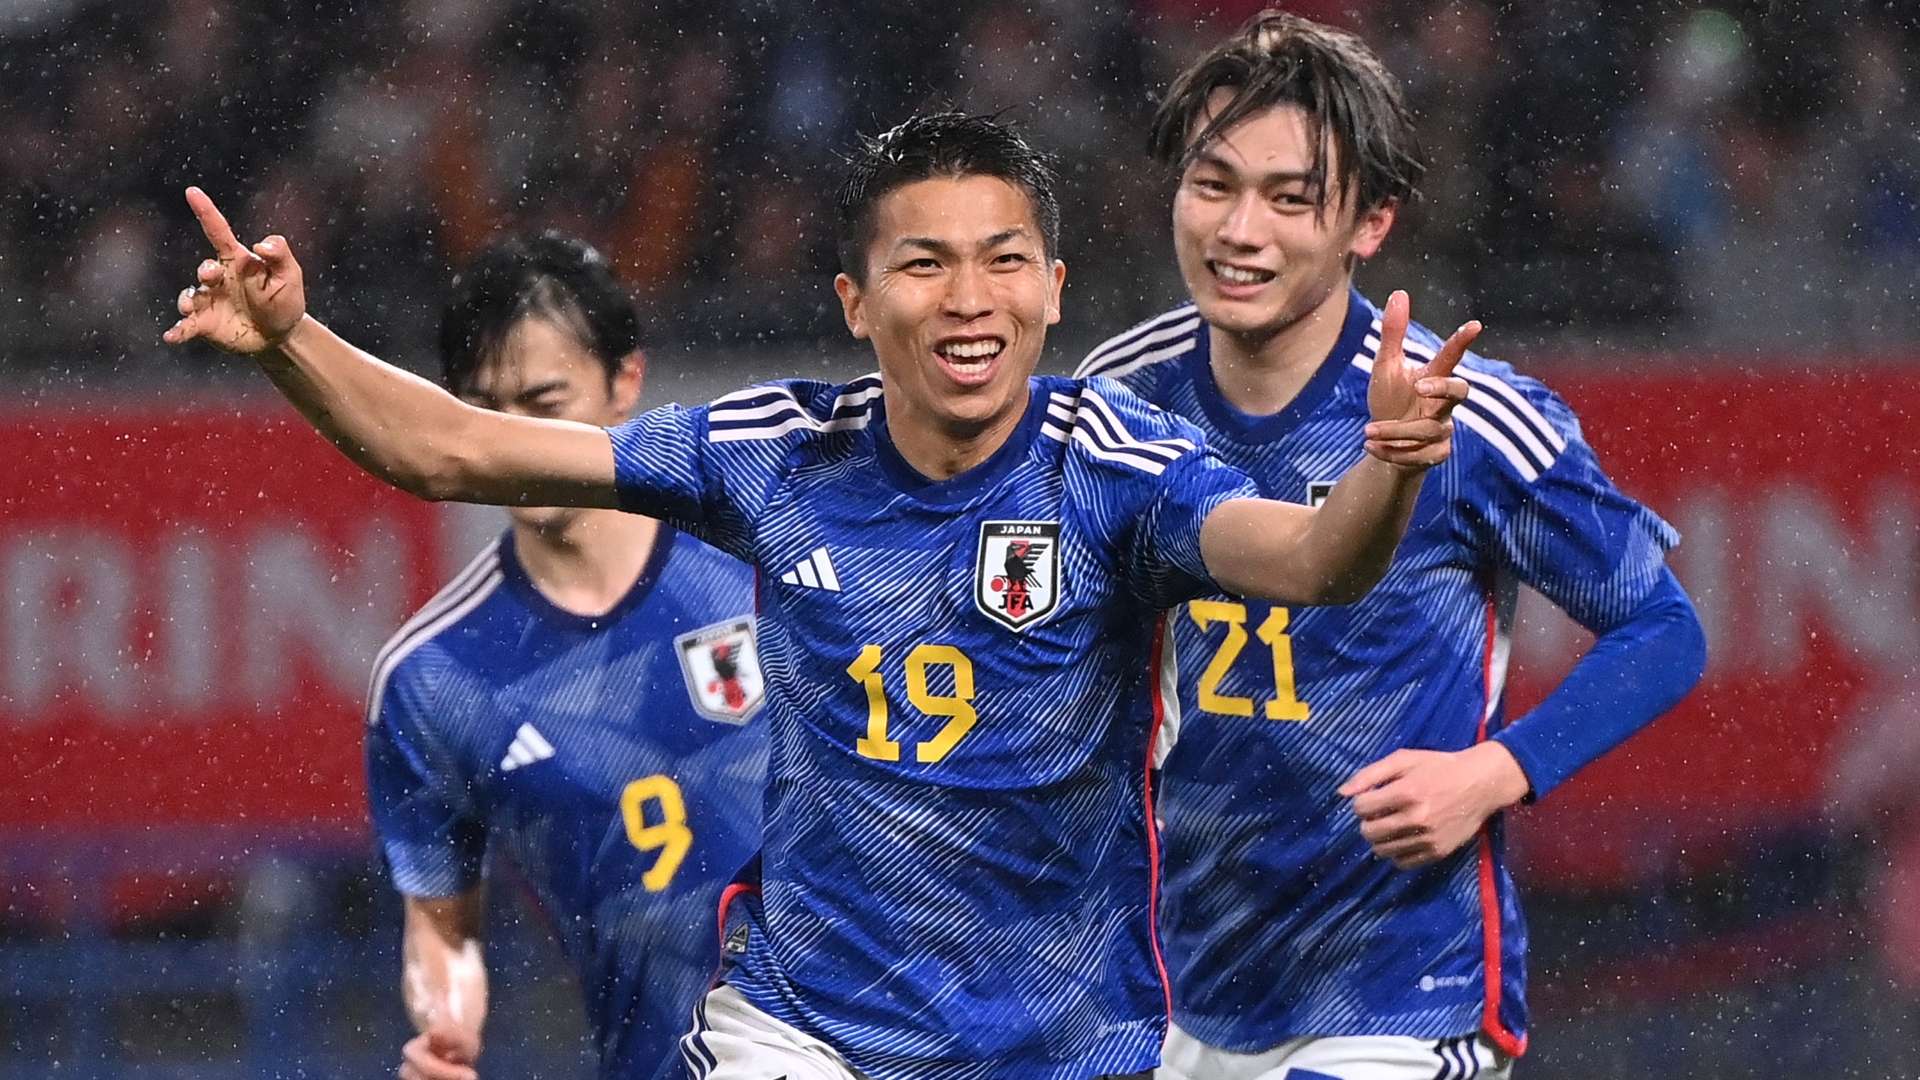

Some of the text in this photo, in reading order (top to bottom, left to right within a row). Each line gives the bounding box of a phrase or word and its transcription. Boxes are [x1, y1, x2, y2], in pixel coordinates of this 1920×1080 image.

[1000, 525, 1041, 535] JAPAN
[7, 520, 404, 716] RIN
[998, 594, 1034, 610] JFA
[1188, 600, 1311, 721] 21
[846, 644, 978, 763] 19
[620, 774, 693, 892] 9
